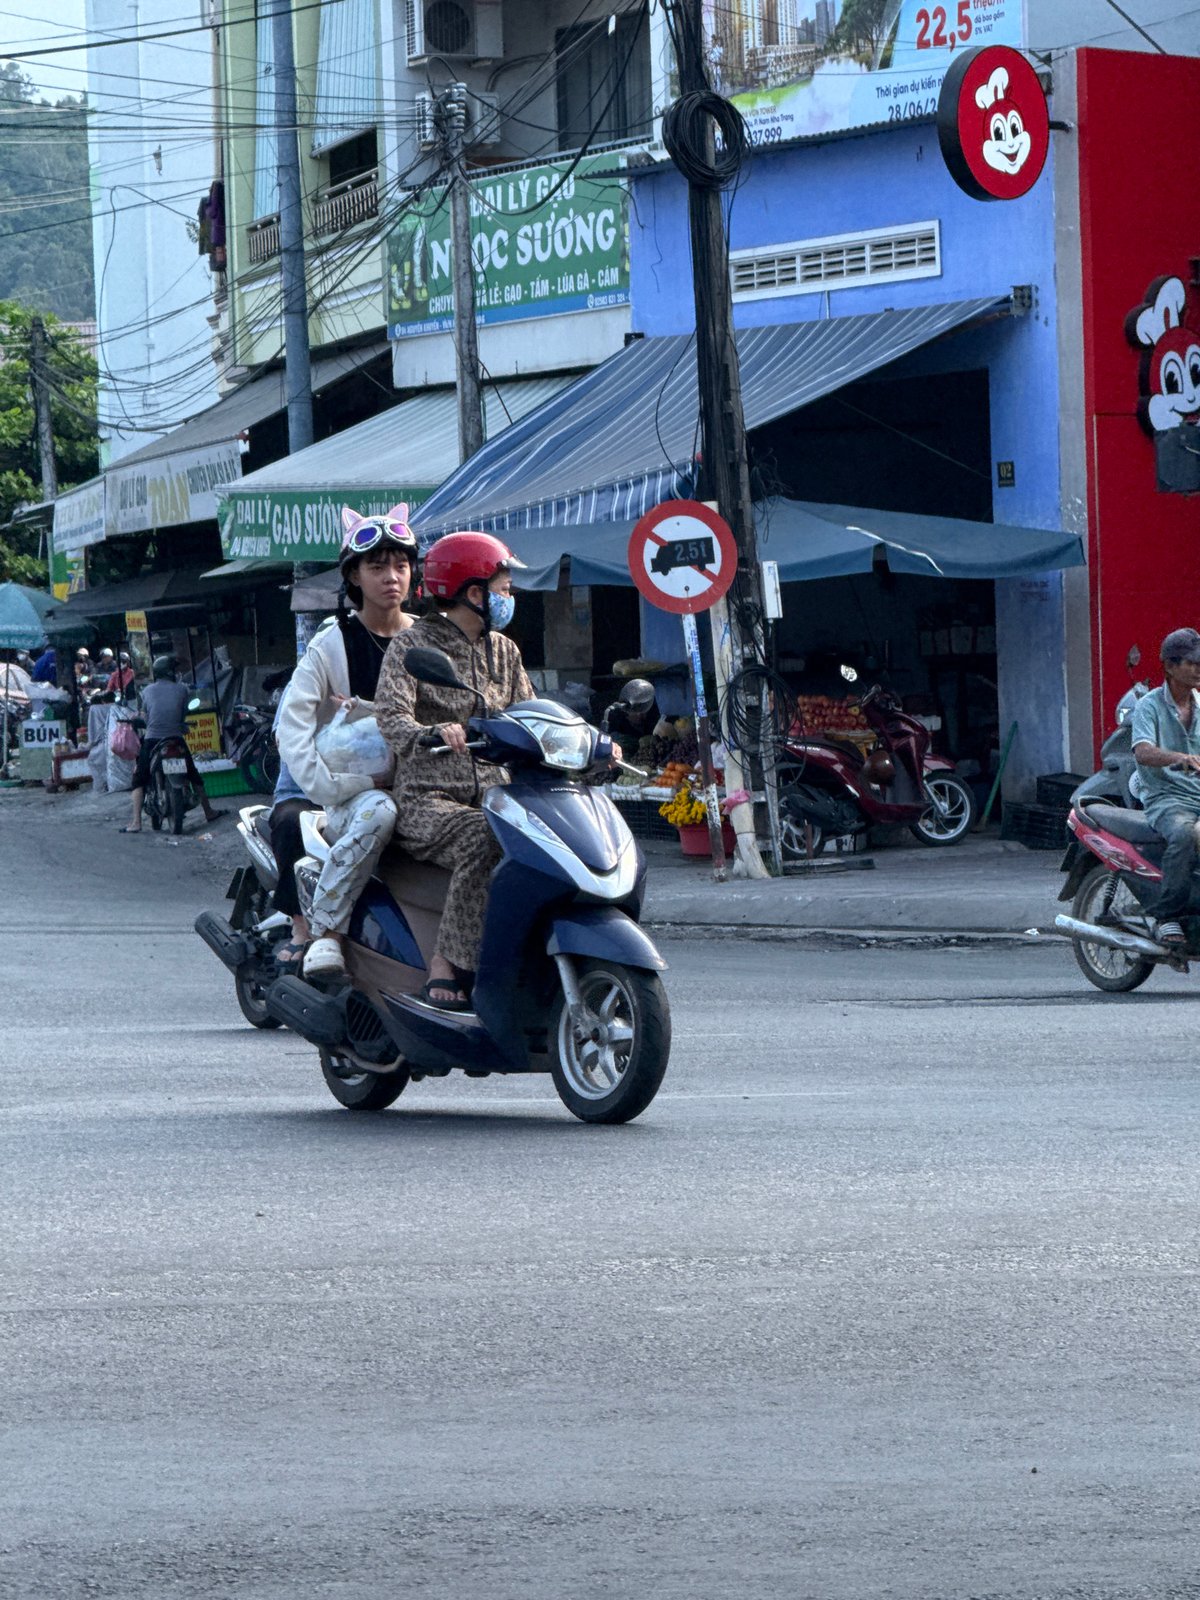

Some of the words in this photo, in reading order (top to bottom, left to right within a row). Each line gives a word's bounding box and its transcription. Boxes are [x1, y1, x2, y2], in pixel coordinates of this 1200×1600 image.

[915, 1, 973, 53] 22,5
[982, 11, 993, 23] bao
[983, 23, 993, 34] VAT
[876, 84, 892, 99] Thời
[892, 82, 909, 99] gian
[910, 79, 920, 96] dự
[920, 74, 937, 91] kiến
[470, 184, 503, 222] ĐẠI
[508, 173, 531, 212] LÝ
[536, 171, 576, 209] GẠO
[431, 228, 509, 284] NỌC
[516, 207, 617, 266] SƯƠNG
[504, 282, 522, 306] GẠO
[530, 273, 550, 299] TẤM
[557, 271, 575, 294] LÚA
[576, 268, 590, 291] GÀ
[597, 264, 619, 288] CÁM
[1000, 463, 1012, 478] 02
[237, 499, 255, 530] ĐẠI
[258, 494, 271, 525] LÝ
[272, 503, 300, 556] GẠO
[674, 540, 708, 562] 2,5t
[24, 724, 60, 744] BÚN
